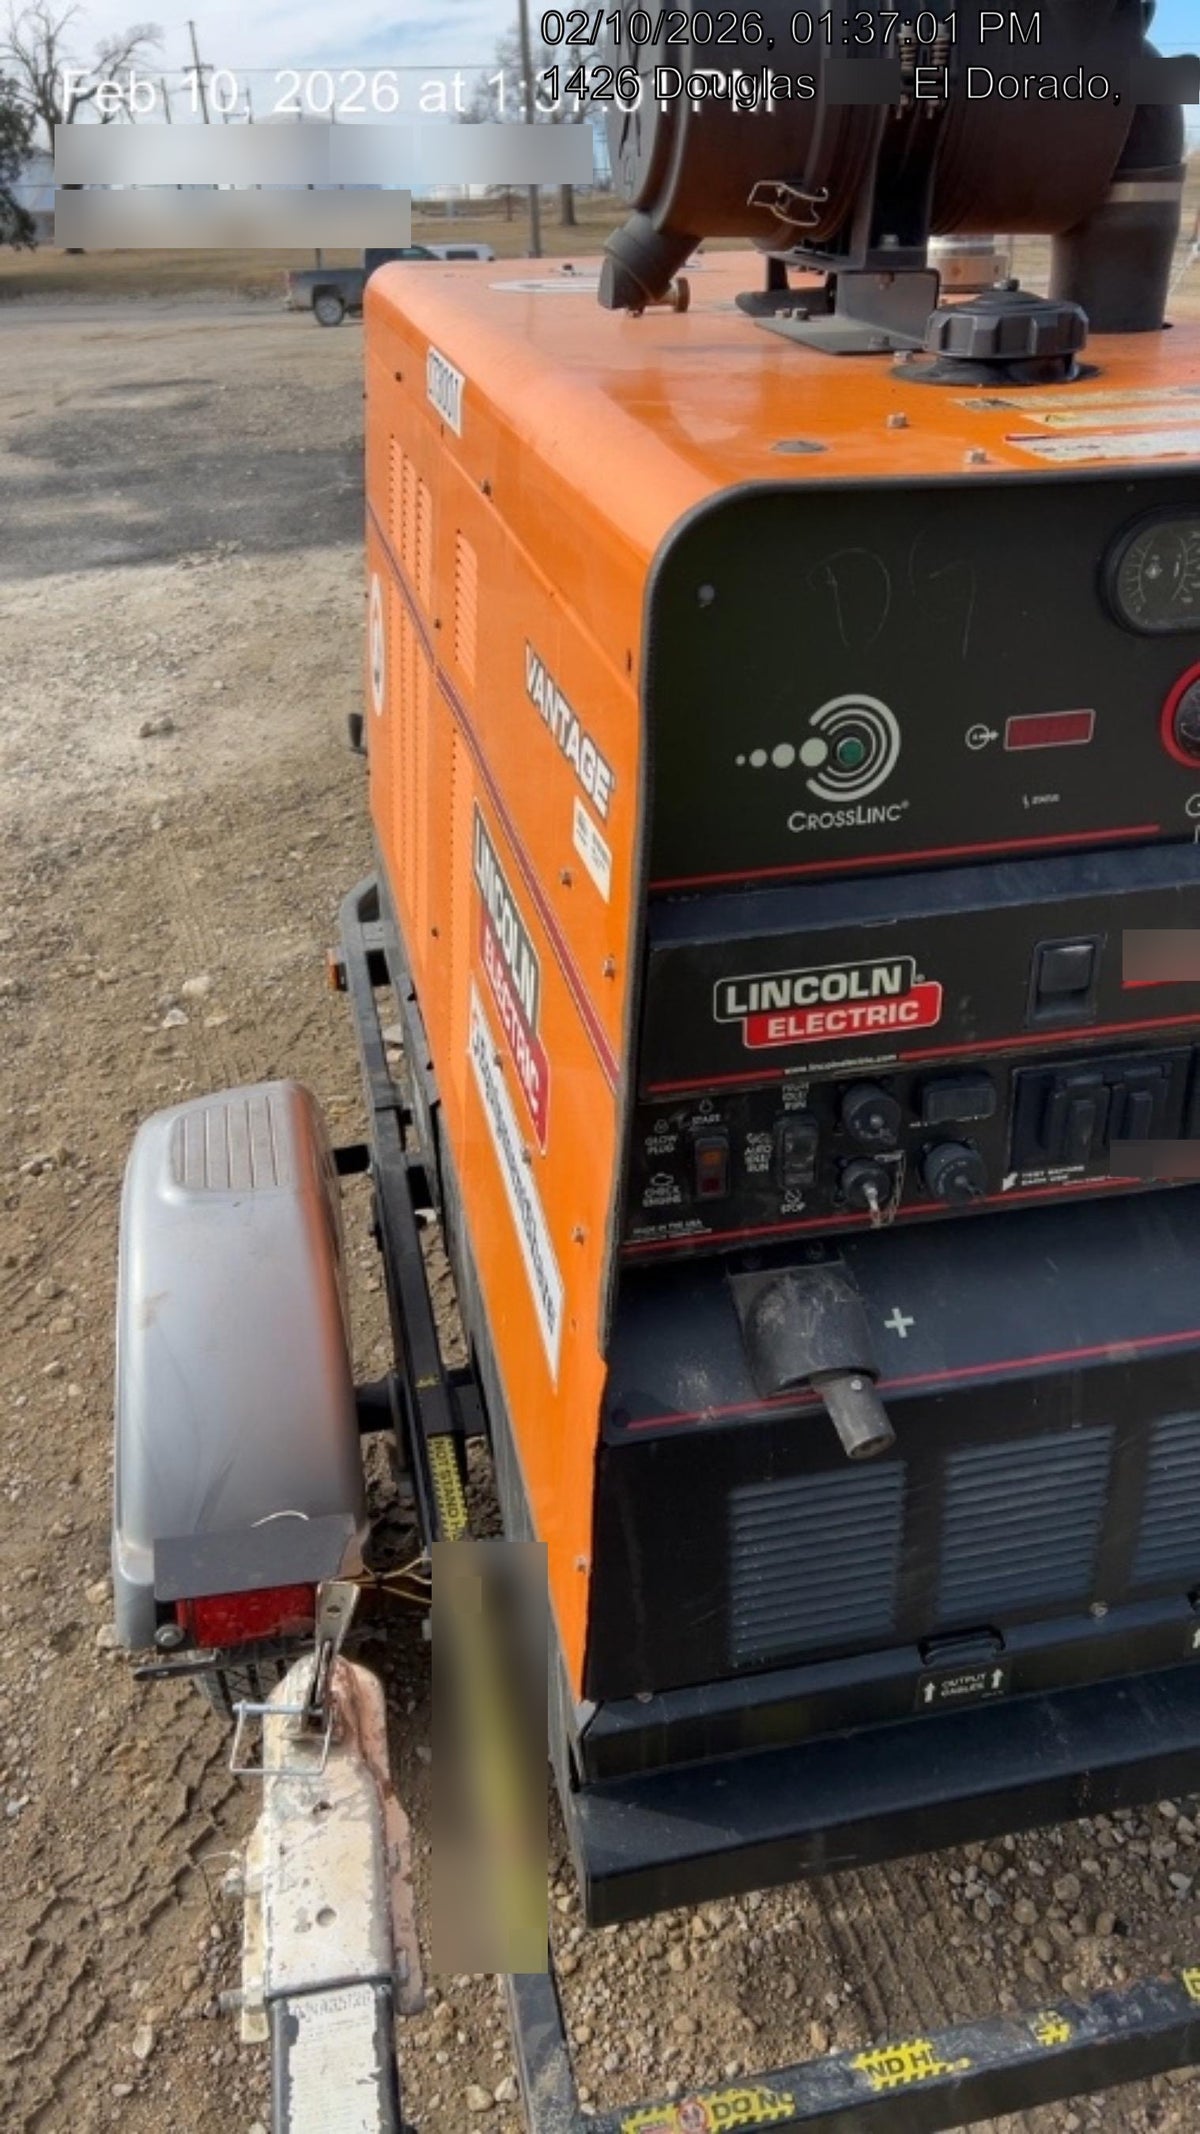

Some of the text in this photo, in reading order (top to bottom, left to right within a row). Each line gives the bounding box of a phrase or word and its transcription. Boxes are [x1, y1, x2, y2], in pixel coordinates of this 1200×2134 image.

[525, 641, 612, 820] VANTAGE
[725, 963, 903, 1015] LINCOLN
[767, 999, 921, 1040] ELECTRIC
[711, 2096, 752, 2119] DO
